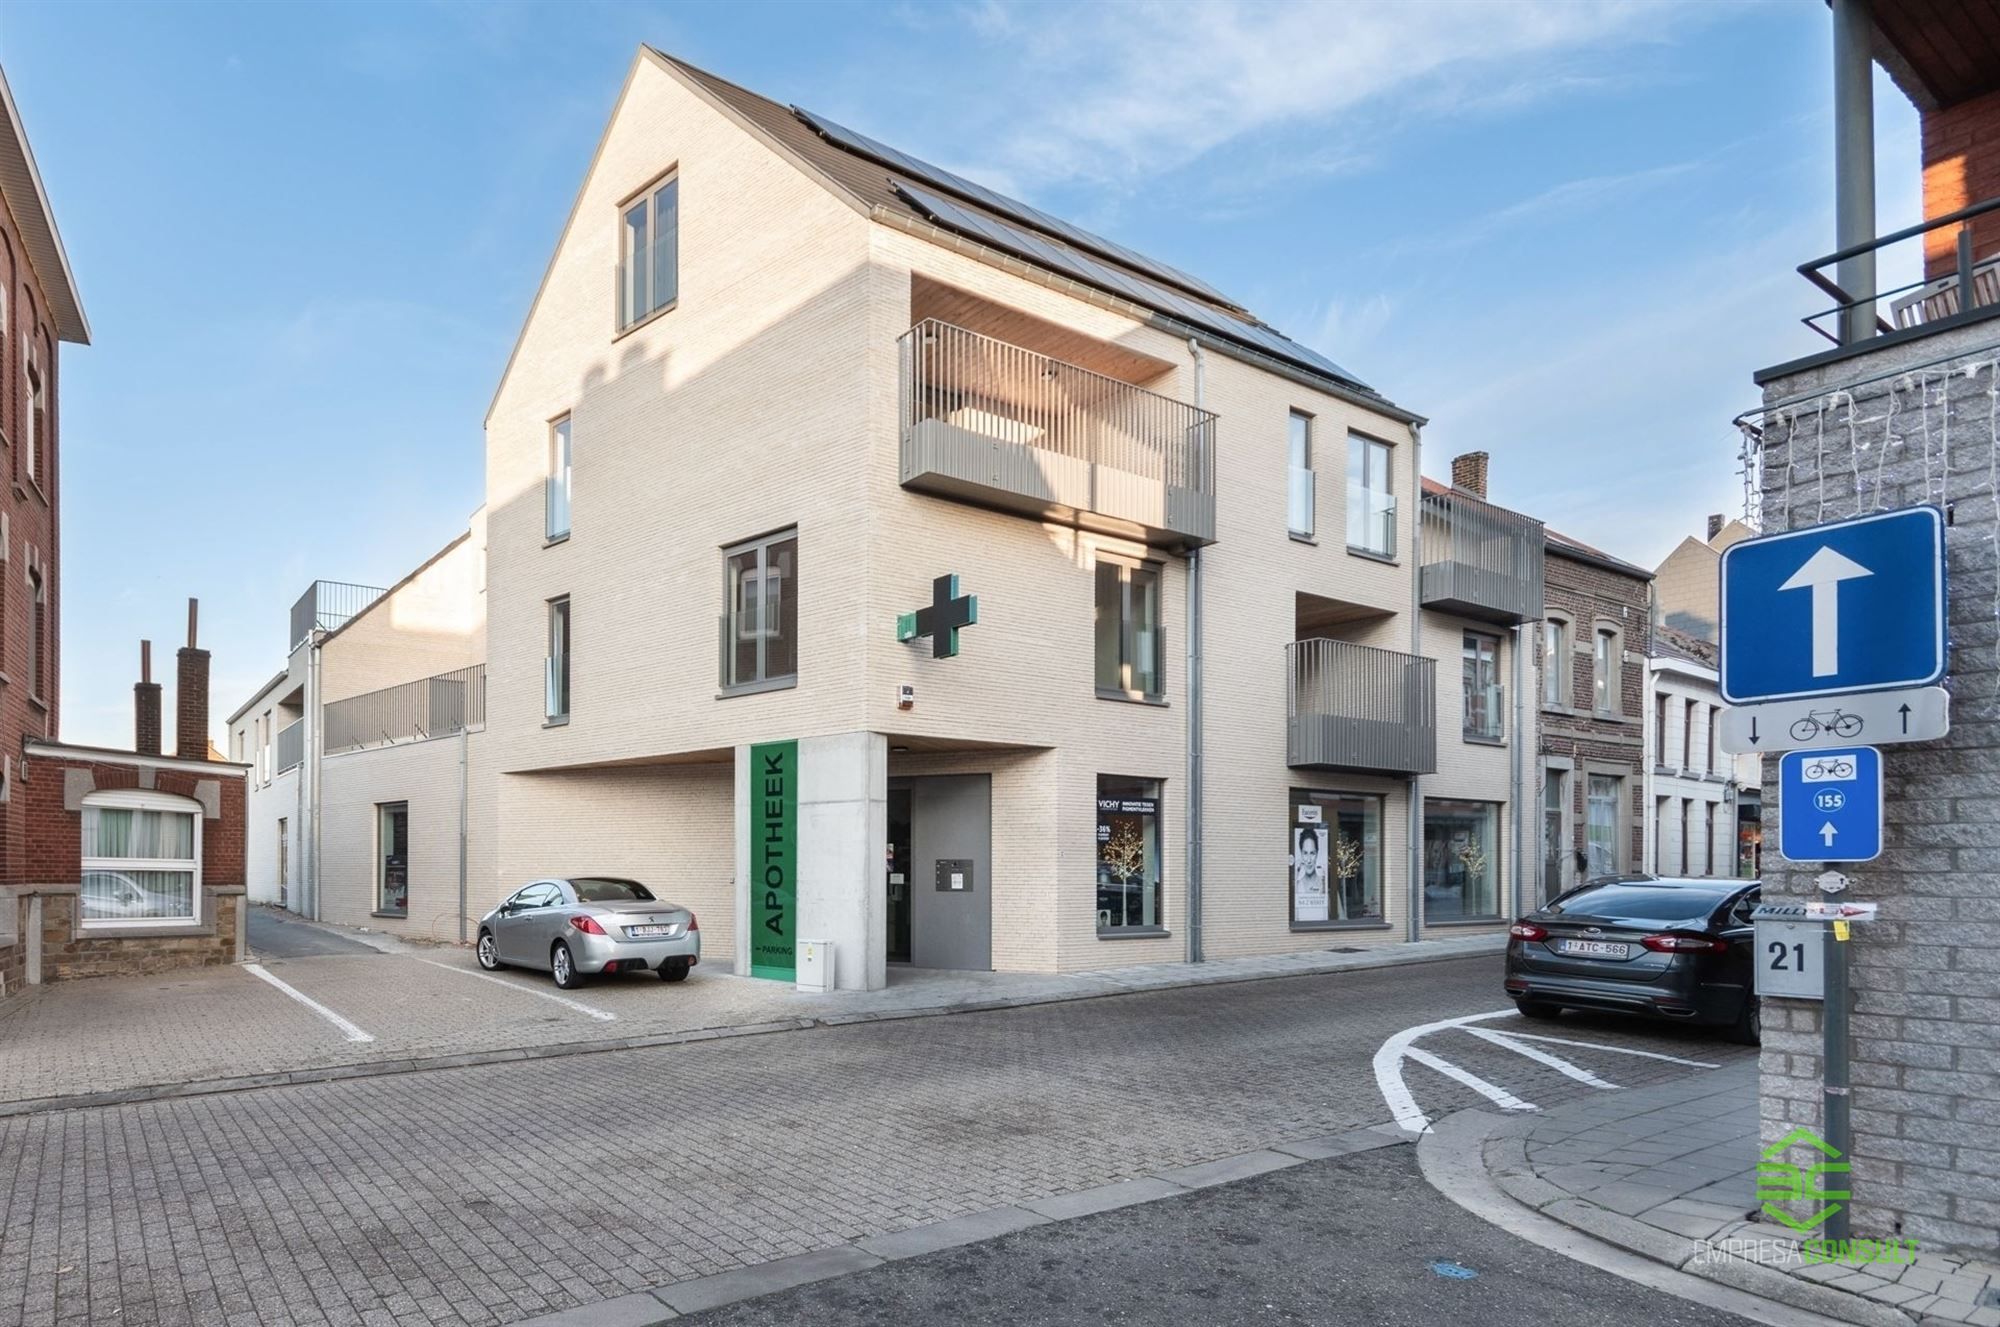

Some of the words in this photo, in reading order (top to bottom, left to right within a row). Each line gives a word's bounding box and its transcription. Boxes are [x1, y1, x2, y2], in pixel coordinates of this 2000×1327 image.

[1098, 800, 1120, 808] VICHY
[1818, 794, 1842, 808] 155
[765, 752, 783, 936] APOTHEEK
[762, 945, 793, 956] PARKING
[1769, 941, 1804, 972] 21
